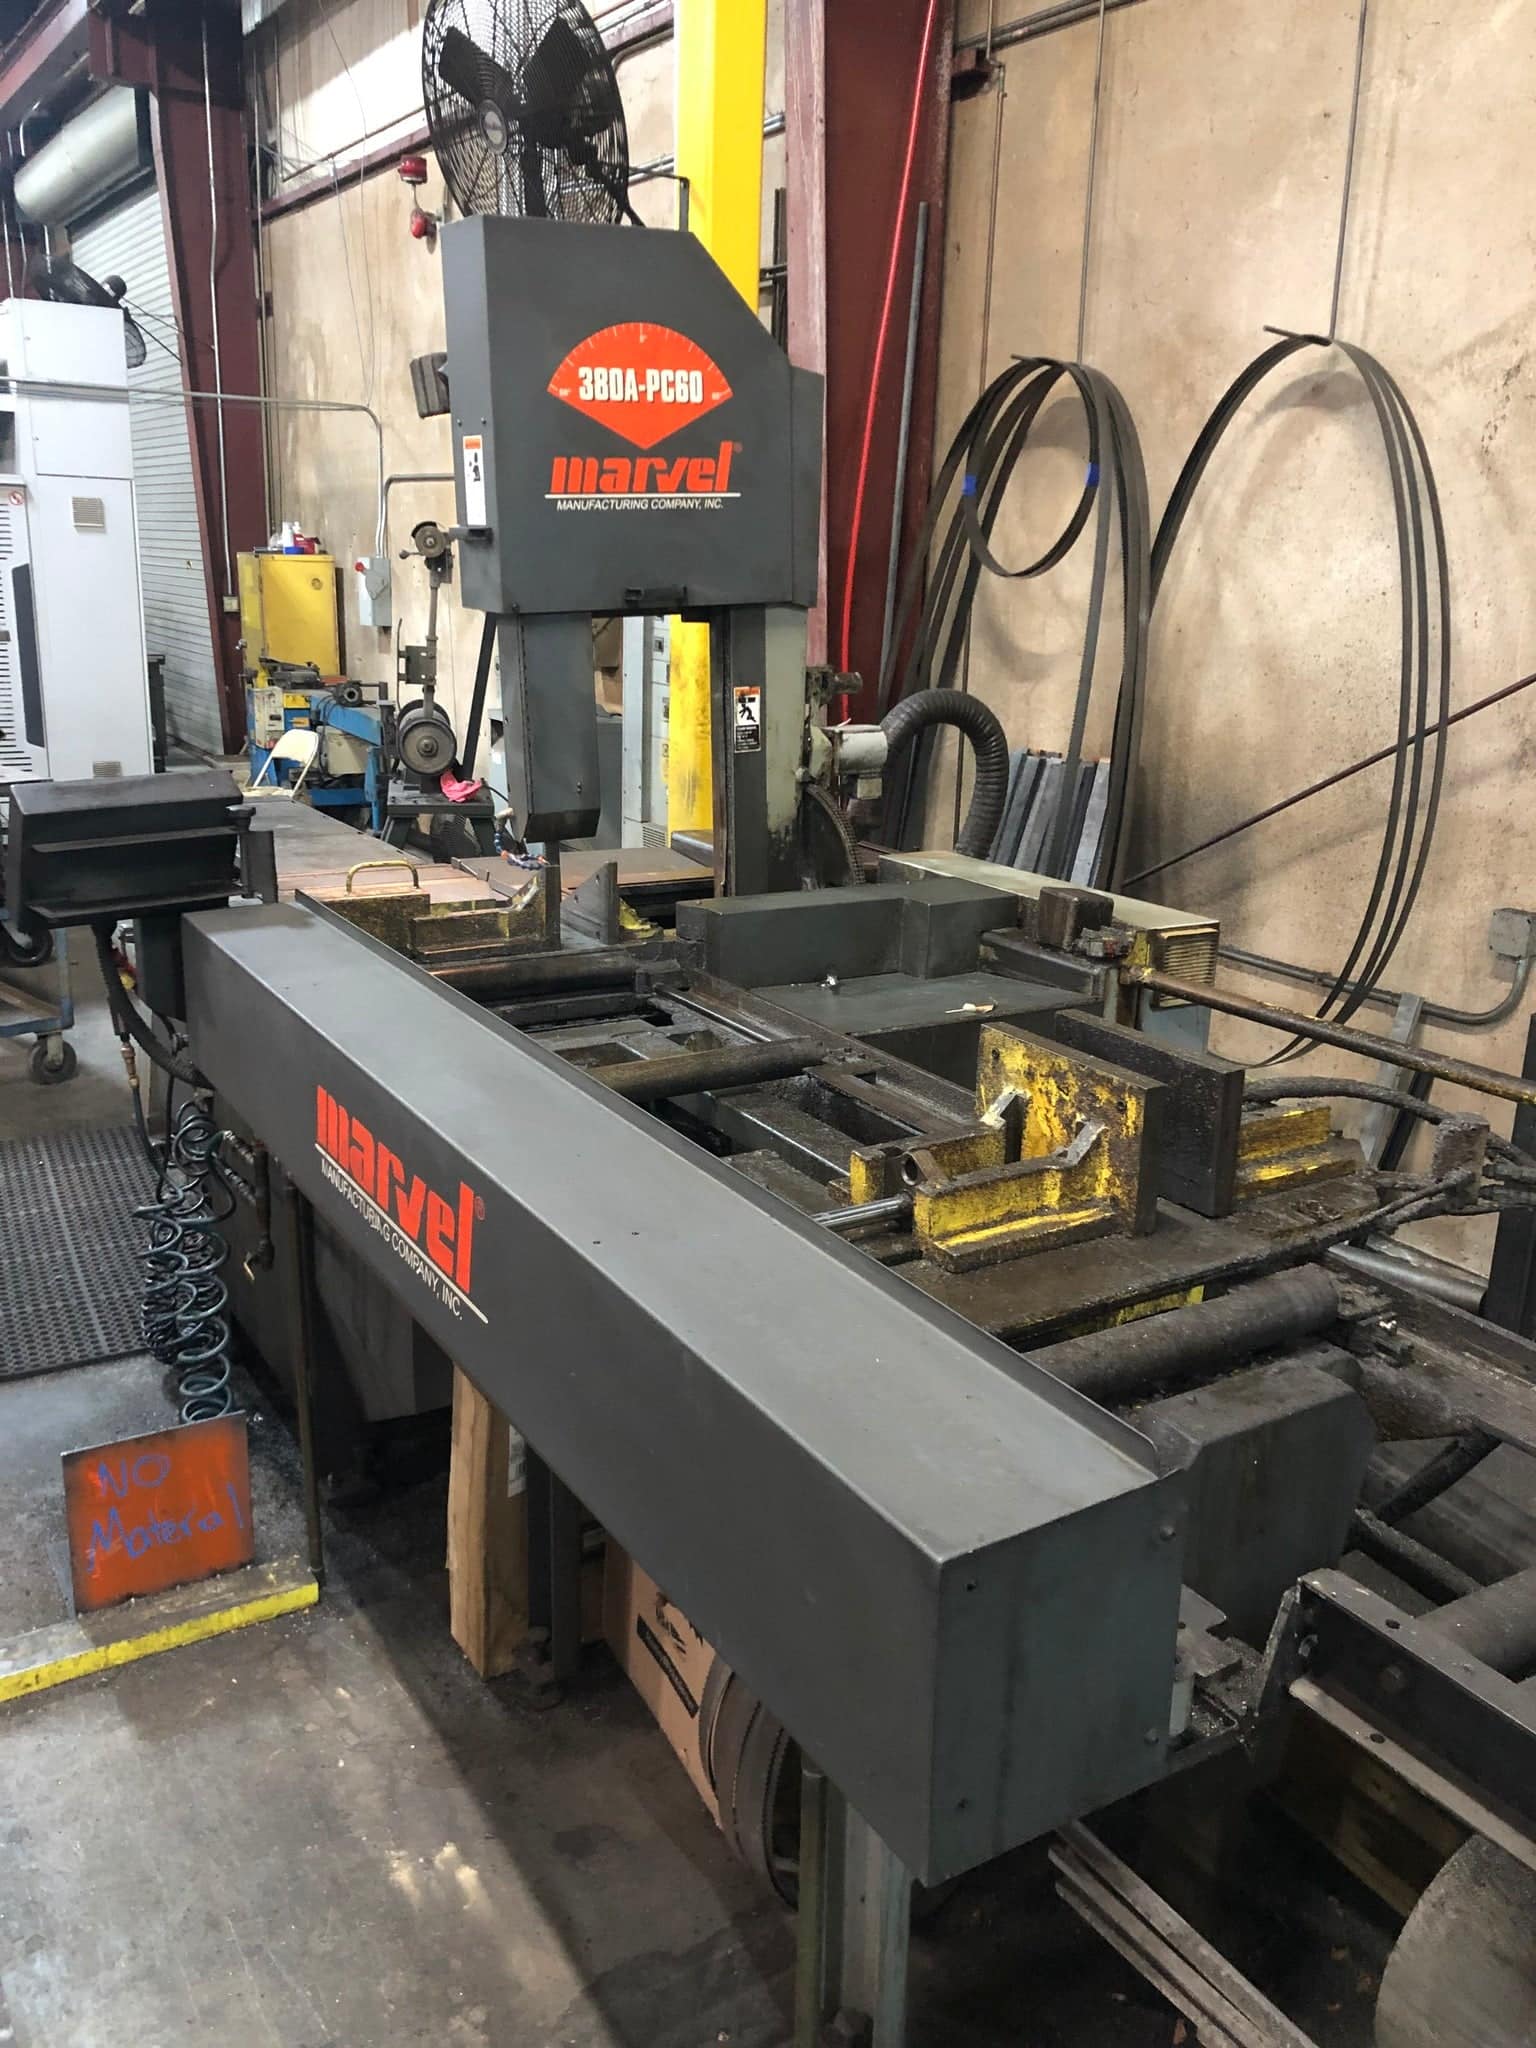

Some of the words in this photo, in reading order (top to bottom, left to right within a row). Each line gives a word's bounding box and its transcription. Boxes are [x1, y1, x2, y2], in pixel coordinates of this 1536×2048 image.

[578, 366, 703, 404] 380A-PC60
[550, 441, 733, 494] marvel
[556, 499, 649, 512] MANUFACTURING
[651, 499, 702, 511] COMPANY,
[704, 498, 724, 510] INC.
[316, 1085, 475, 1294] marvel
[391, 1232, 440, 1299] COMPANY,
[442, 1285, 463, 1321] INC.
[97, 1453, 171, 1498] NO
